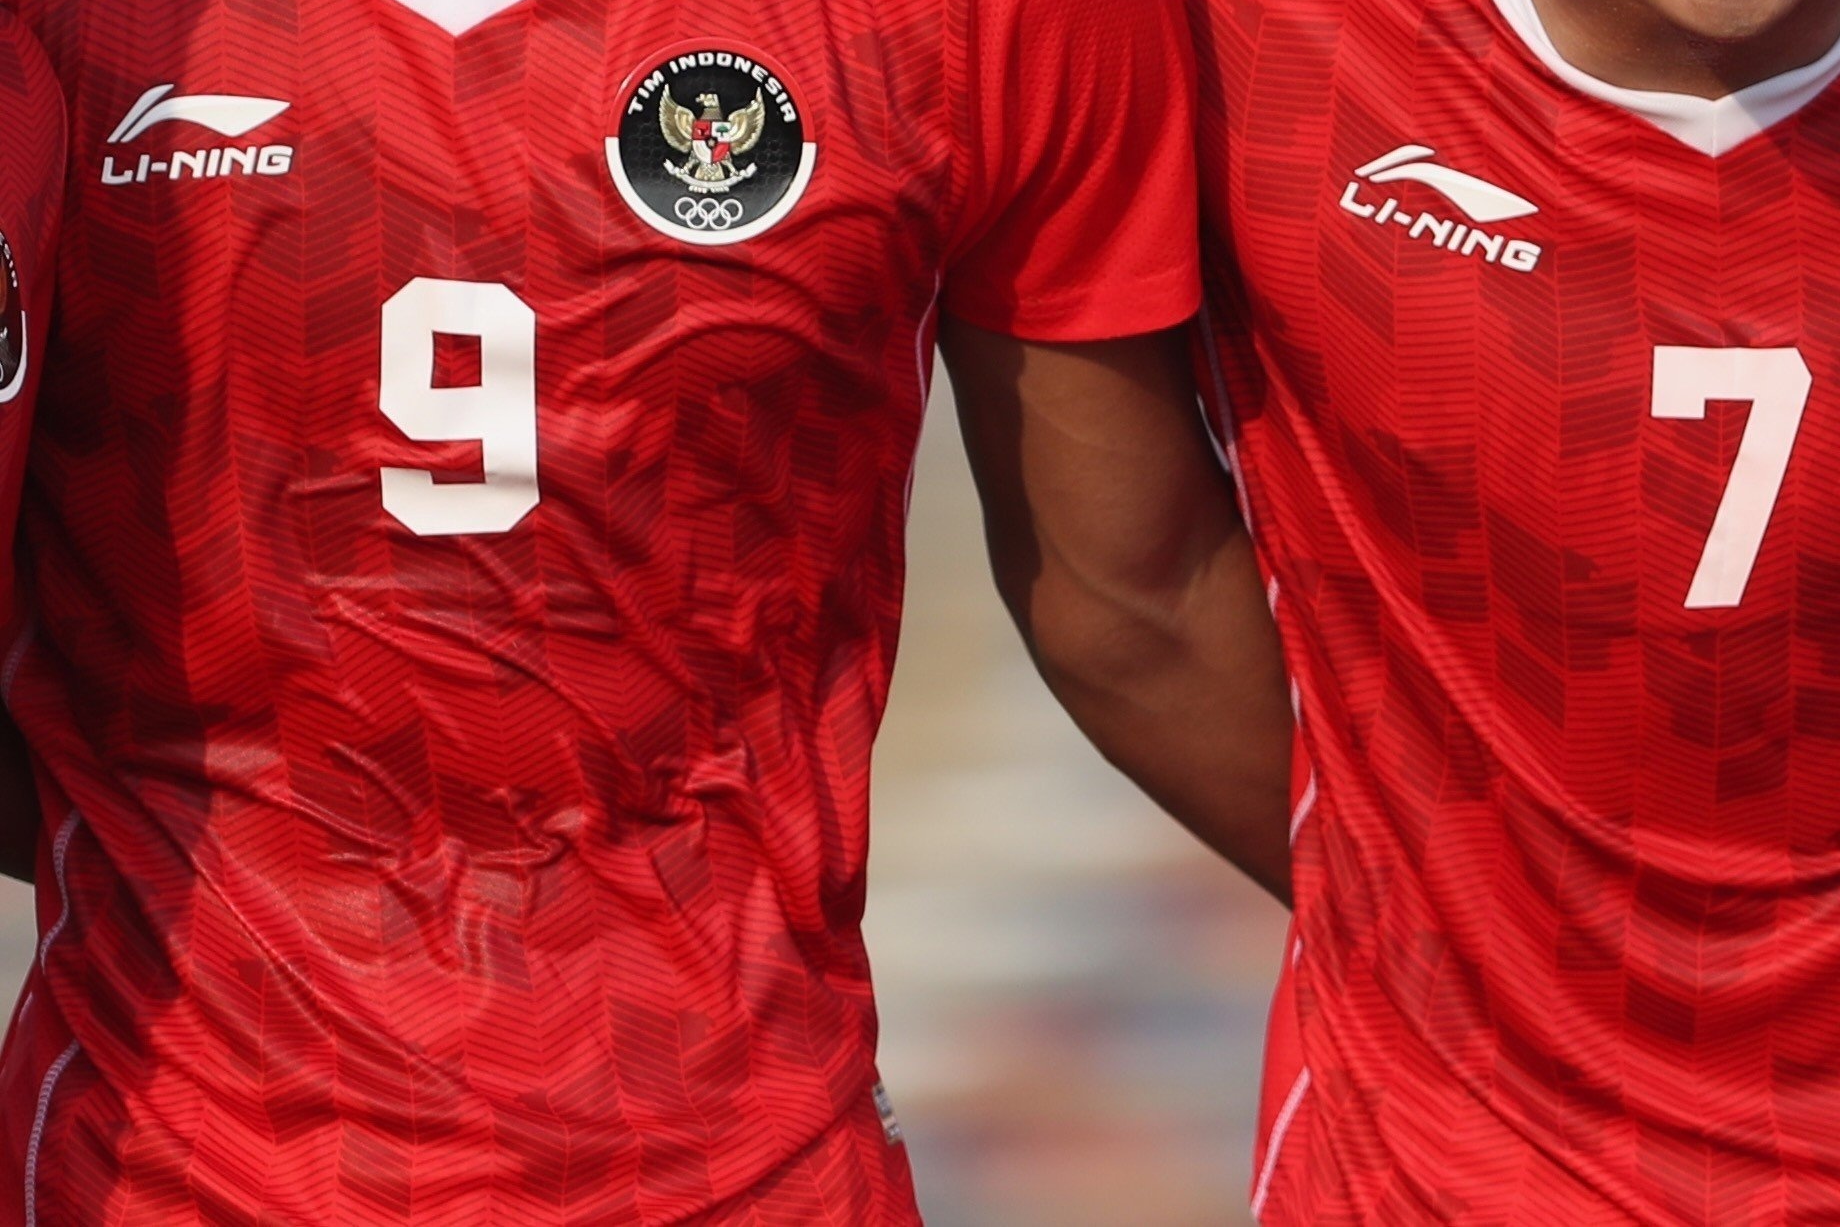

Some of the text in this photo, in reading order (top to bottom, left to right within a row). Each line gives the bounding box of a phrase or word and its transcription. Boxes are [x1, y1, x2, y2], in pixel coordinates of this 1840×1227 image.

[627, 52, 797, 123] TIM INDONESIA
[101, 145, 294, 185] LI-NING
[1339, 181, 1542, 272] LI-NING
[378, 276, 541, 536] 9
[1651, 345, 1813, 609] 7
